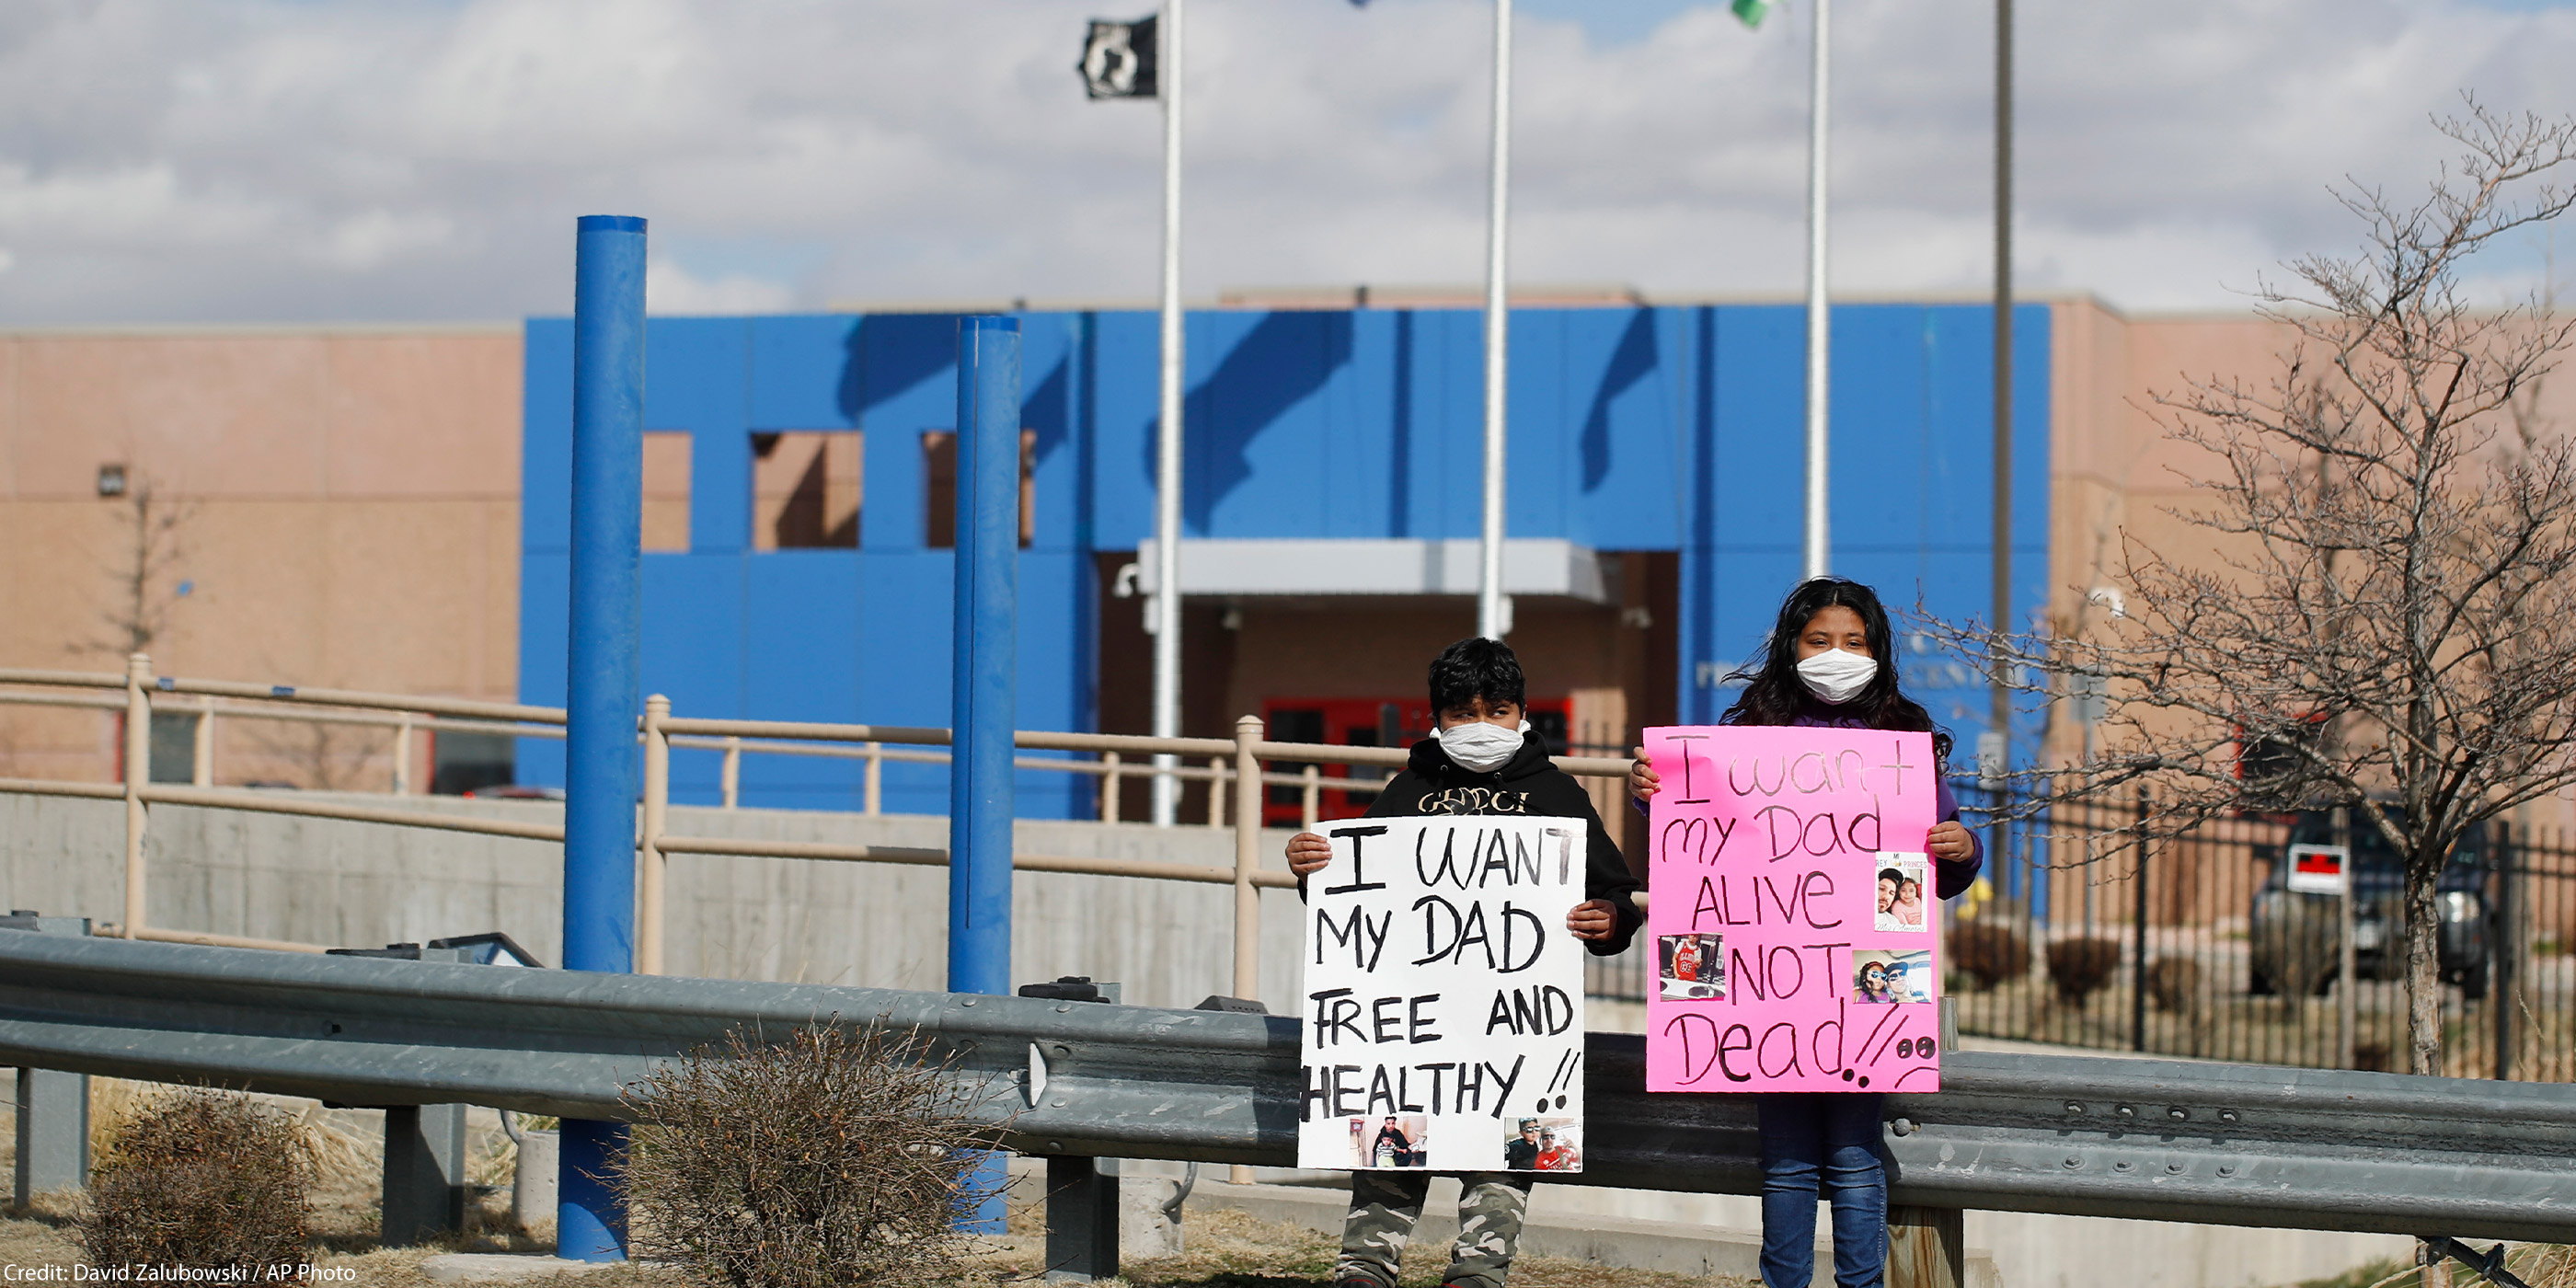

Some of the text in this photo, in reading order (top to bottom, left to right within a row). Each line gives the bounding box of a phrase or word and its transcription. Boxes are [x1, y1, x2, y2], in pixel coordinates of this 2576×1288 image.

[1662, 736, 1914, 804] I want
[1325, 826, 1579, 895] I WANT
[1662, 794, 1880, 866] my Dad
[1317, 895, 1545, 973] MY DAD
[1731, 943, 1851, 1006] NOT
[1309, 985, 1573, 1049] FREE AND
